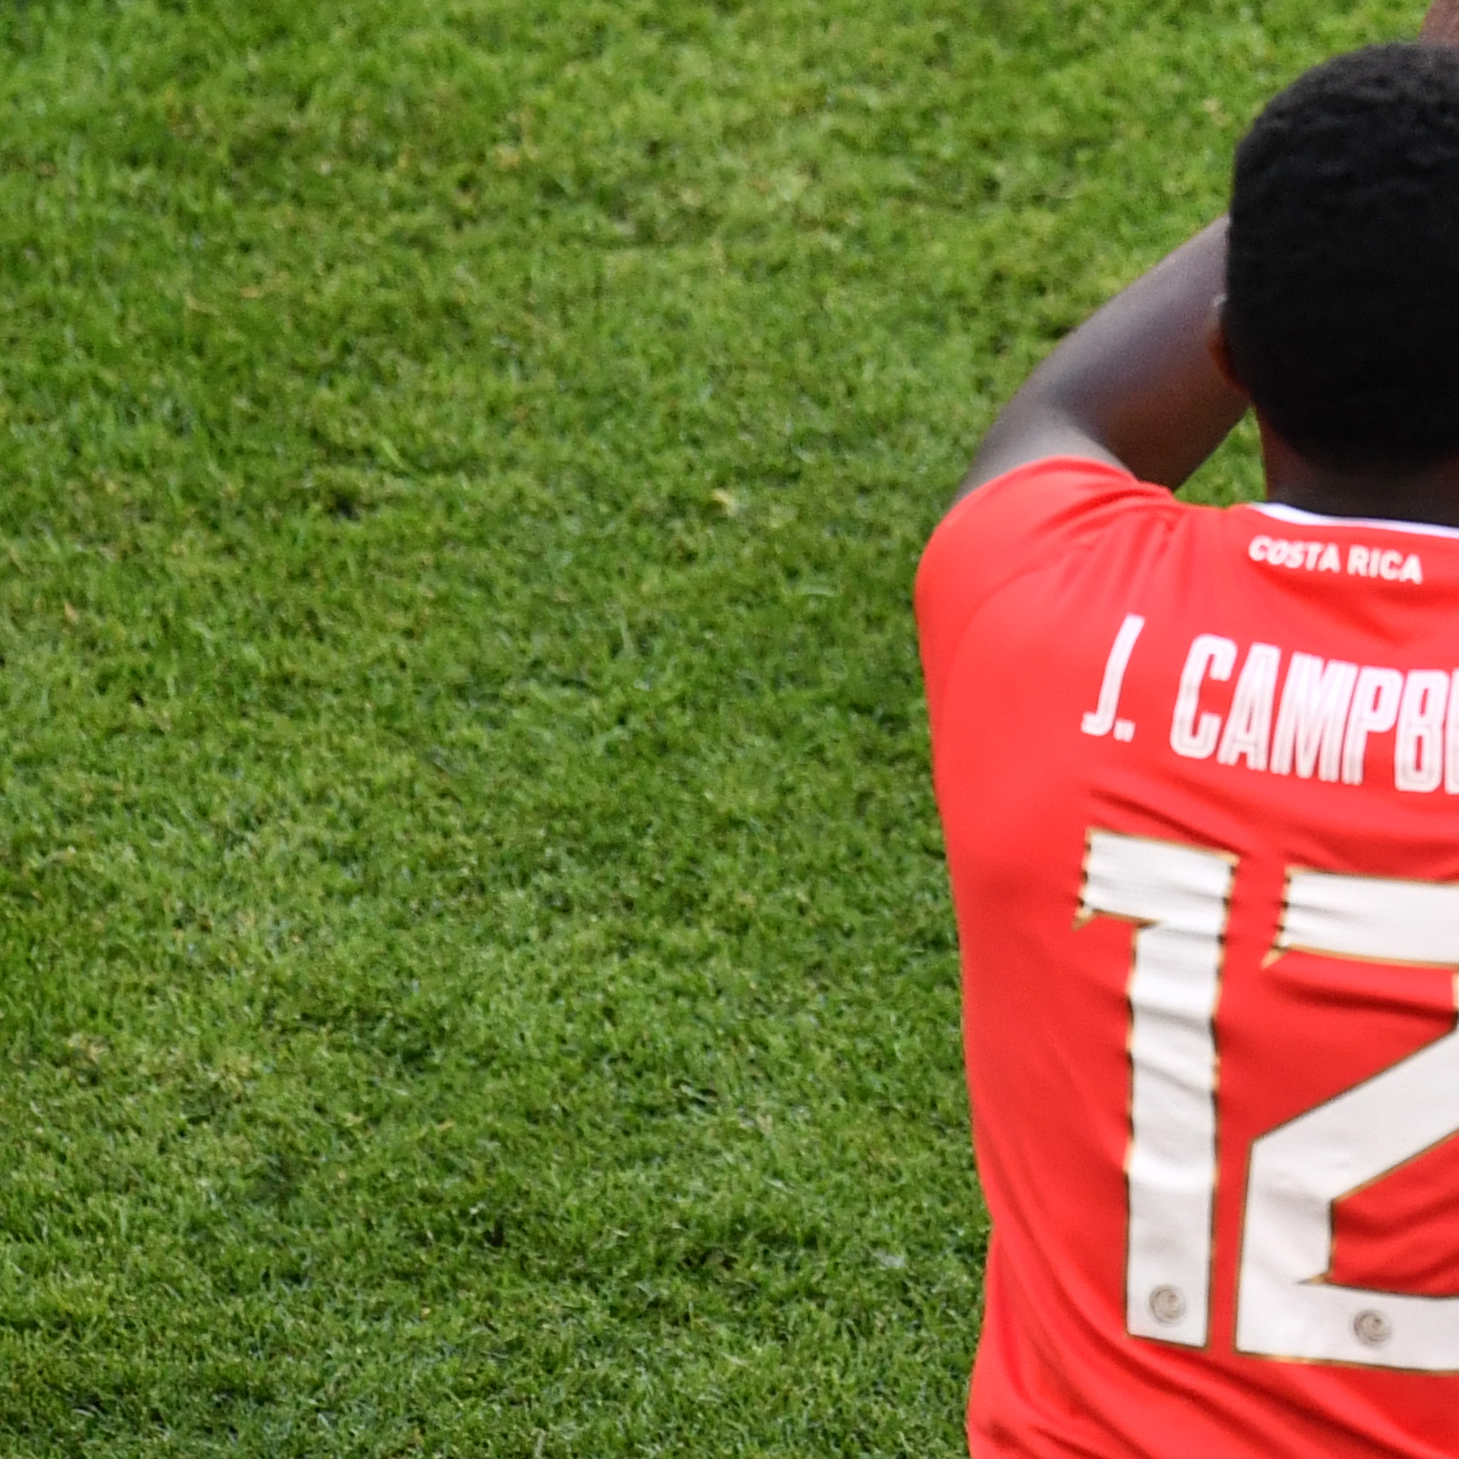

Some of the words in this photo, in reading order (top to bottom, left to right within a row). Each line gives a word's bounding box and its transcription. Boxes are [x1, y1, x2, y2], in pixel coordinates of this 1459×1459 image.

[1248, 535, 1341, 573] COSTA
[1346, 544, 1423, 585] RICA
[1081, 613, 1145, 742] J.
